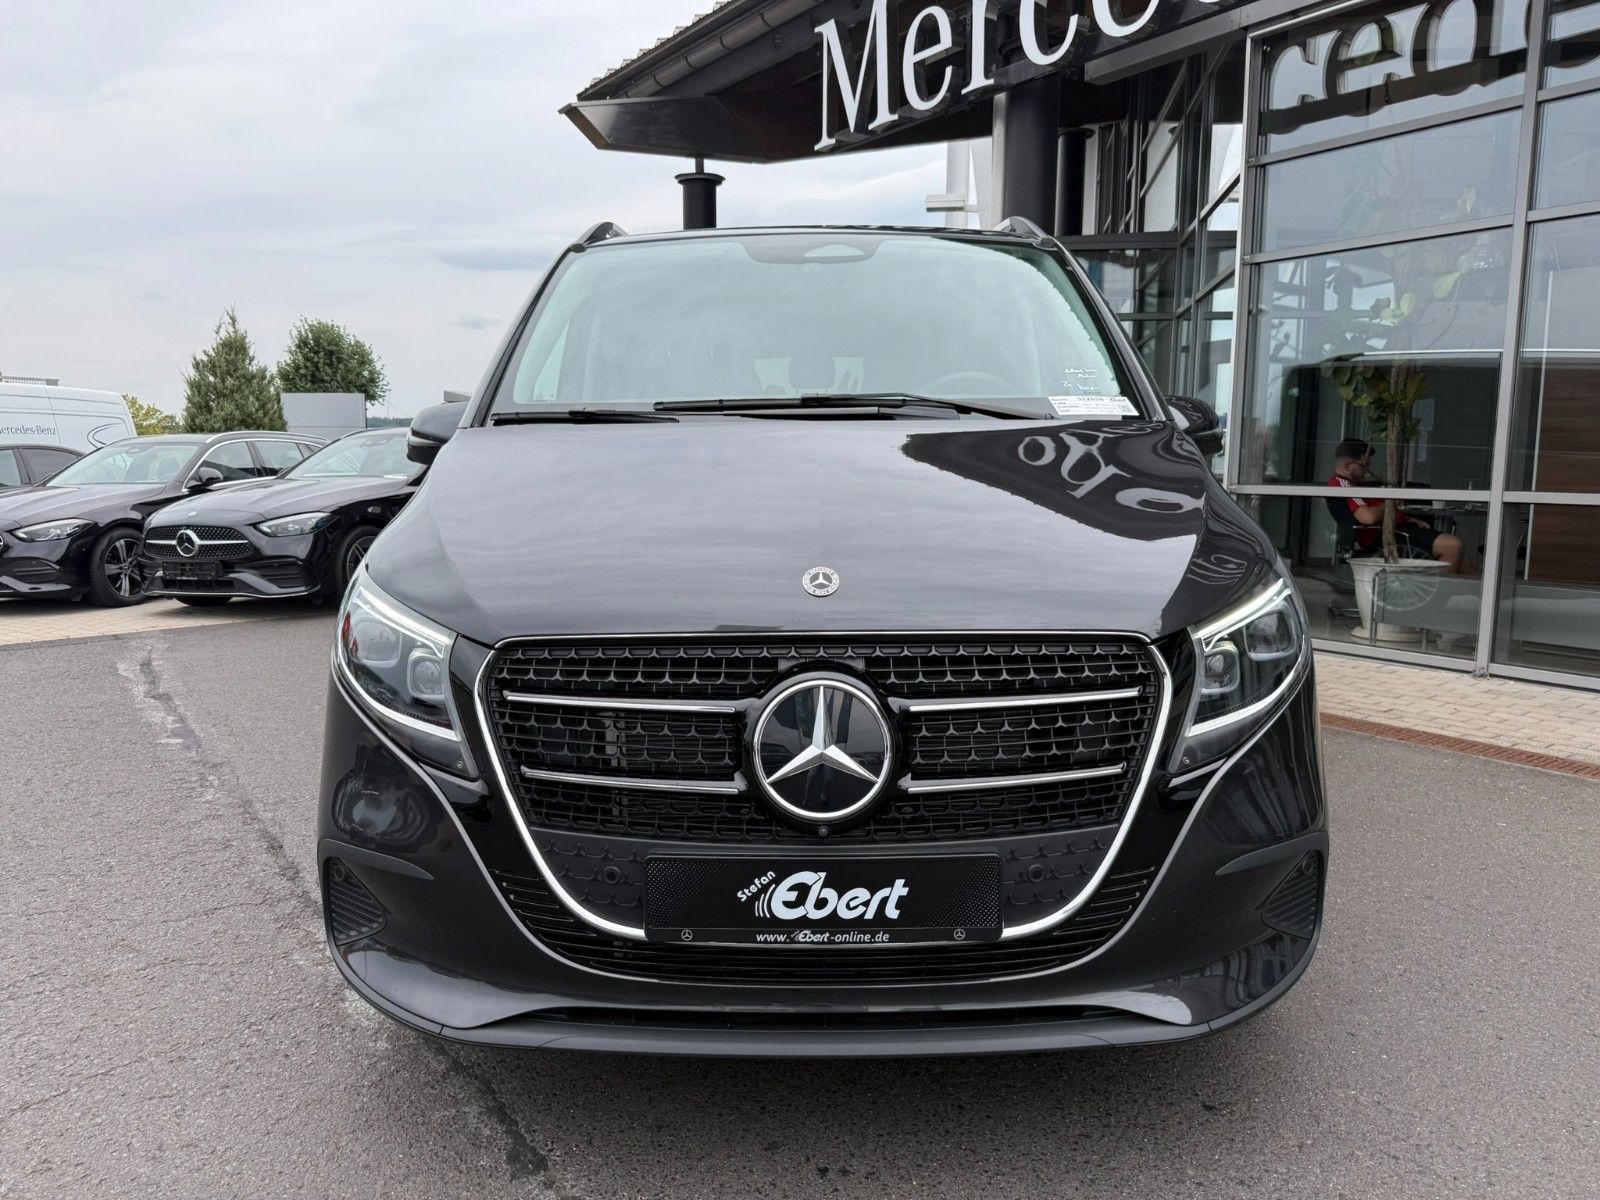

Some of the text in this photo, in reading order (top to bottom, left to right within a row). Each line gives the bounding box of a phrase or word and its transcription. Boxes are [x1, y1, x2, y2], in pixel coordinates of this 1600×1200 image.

[0, 424, 56, 435] ercedes-Benz
[736, 870, 910, 920] Stefan Ebert
